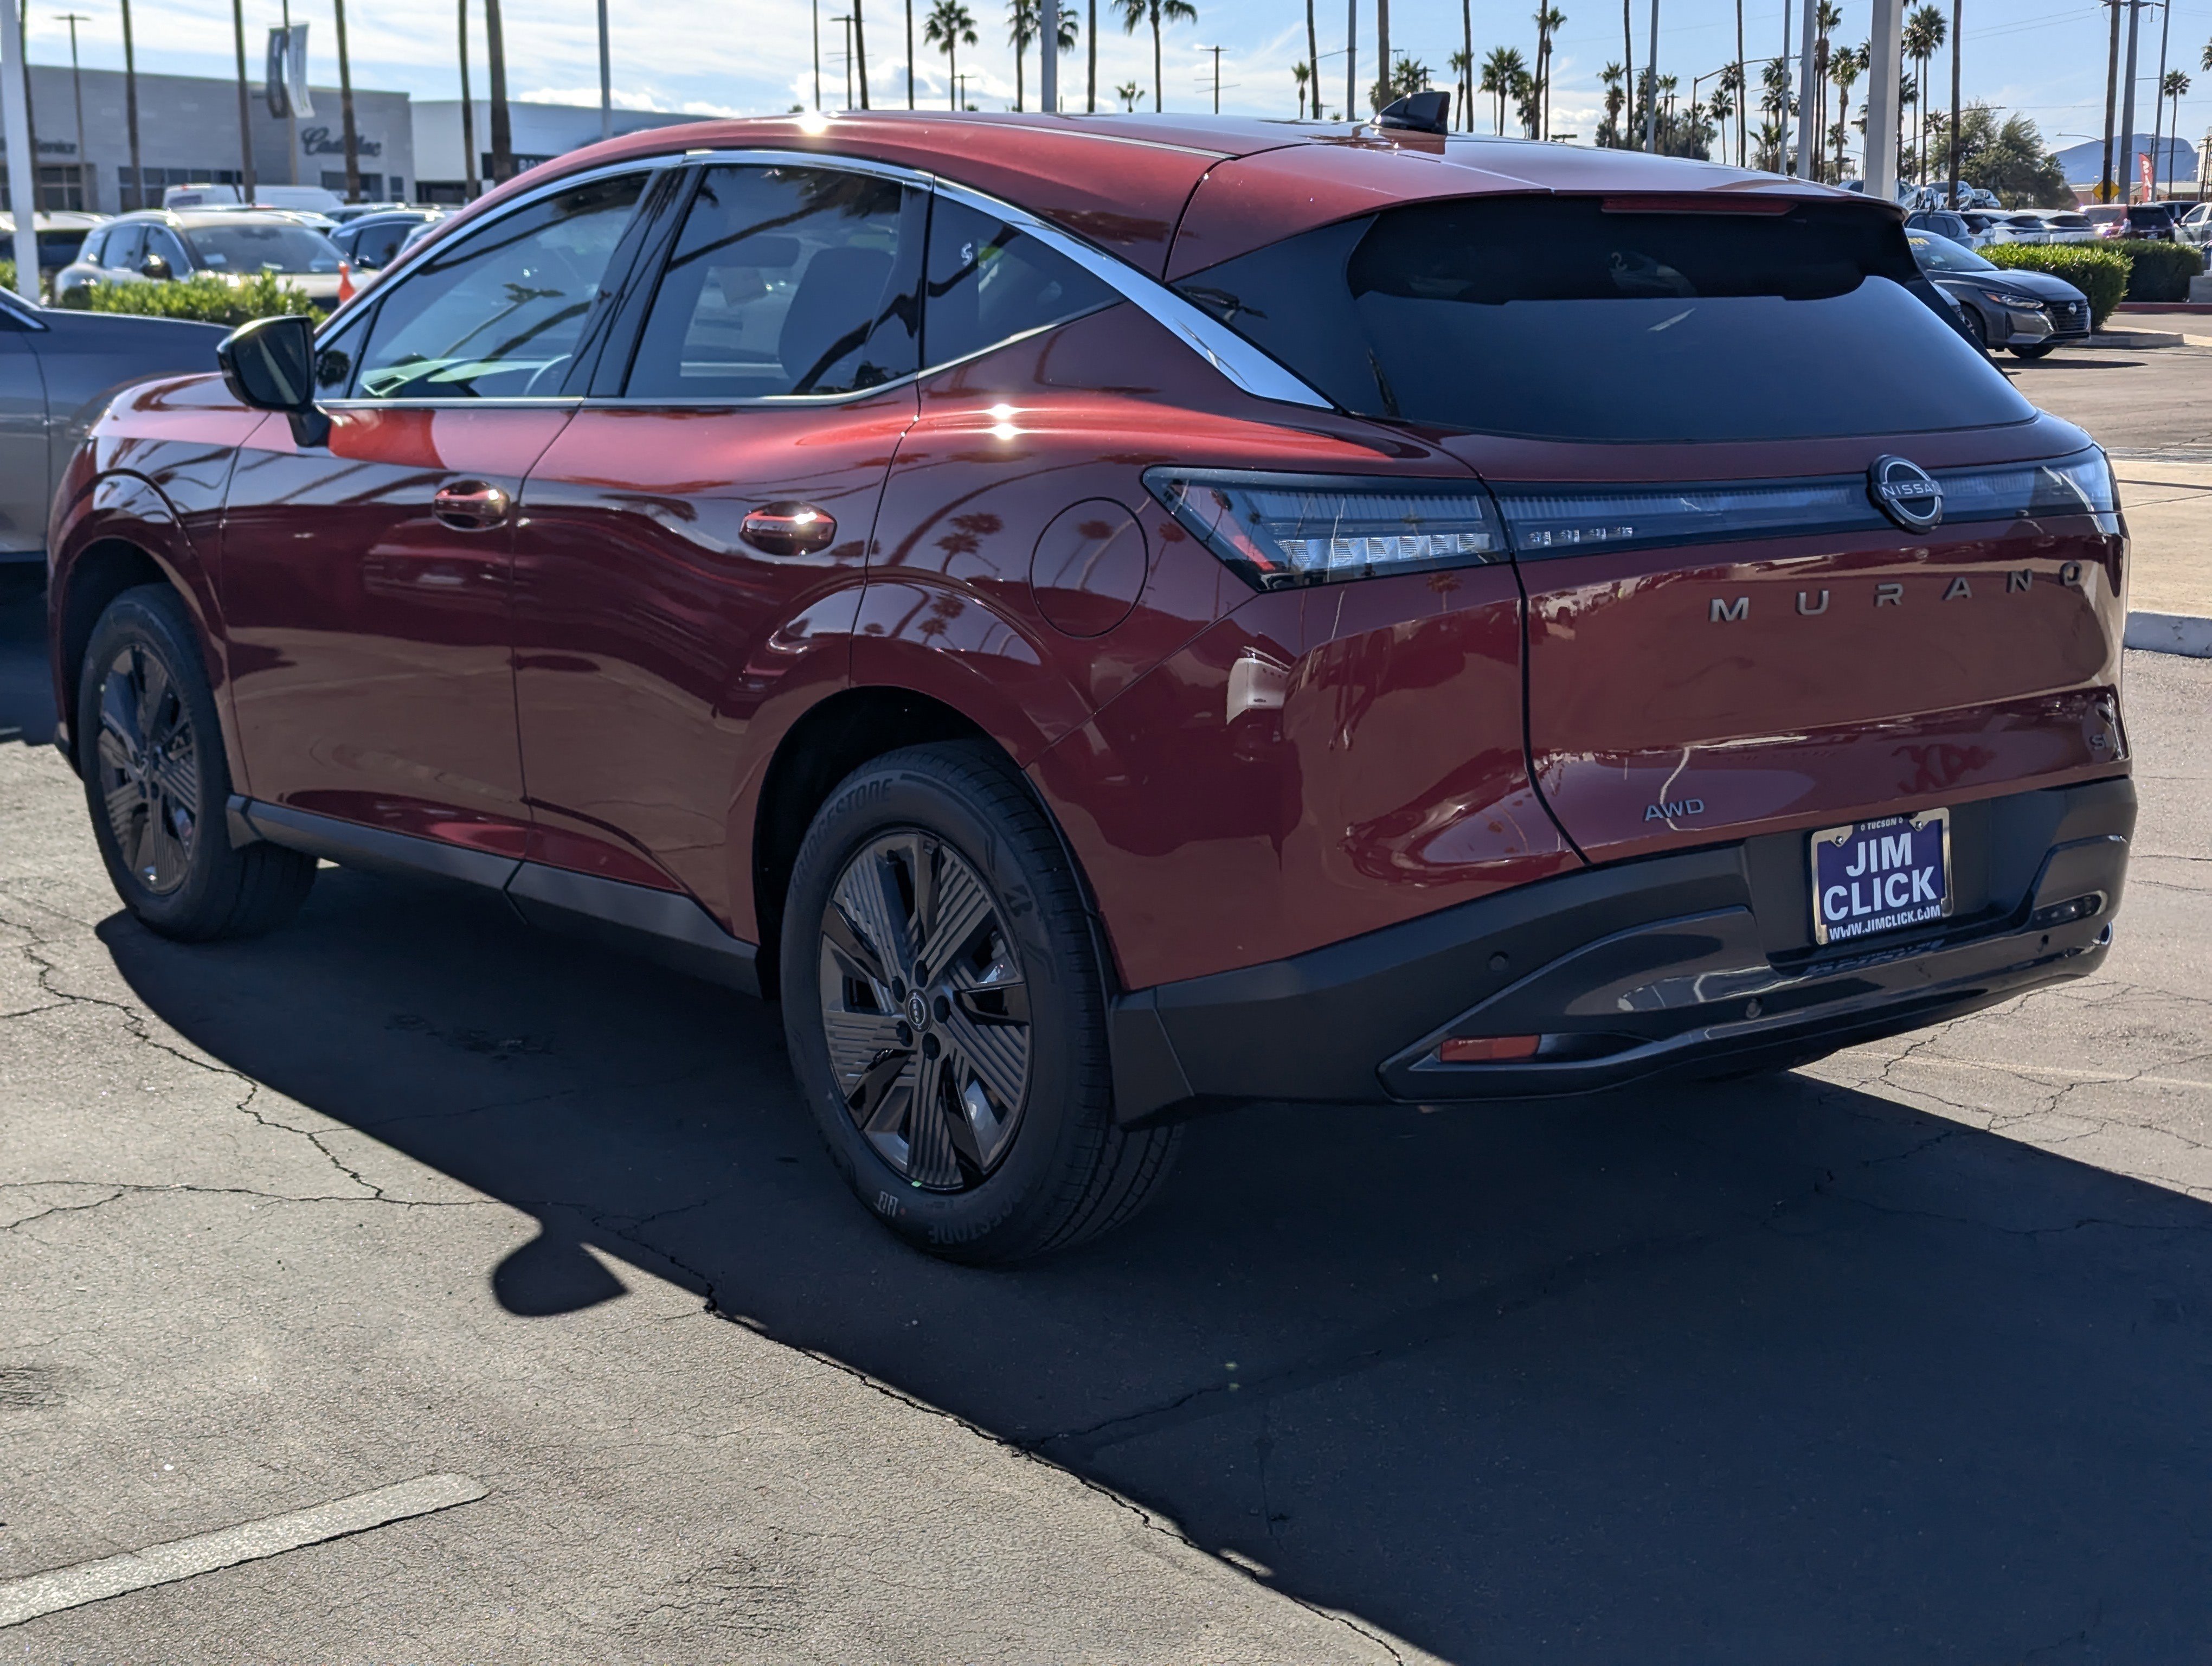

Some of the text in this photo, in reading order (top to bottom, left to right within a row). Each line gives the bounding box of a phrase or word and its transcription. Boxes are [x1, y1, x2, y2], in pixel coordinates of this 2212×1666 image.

[1881, 483, 1941, 497] NISSAN
[1709, 560, 2083, 622] MURANO
[1644, 798, 1705, 822] AWD
[1867, 817, 1897, 830] TUCSON
[1846, 832, 1912, 877] JIM
[1823, 866, 1938, 921] CLICK
[1829, 904, 1941, 940] WWW.JIMCLICK.COM
